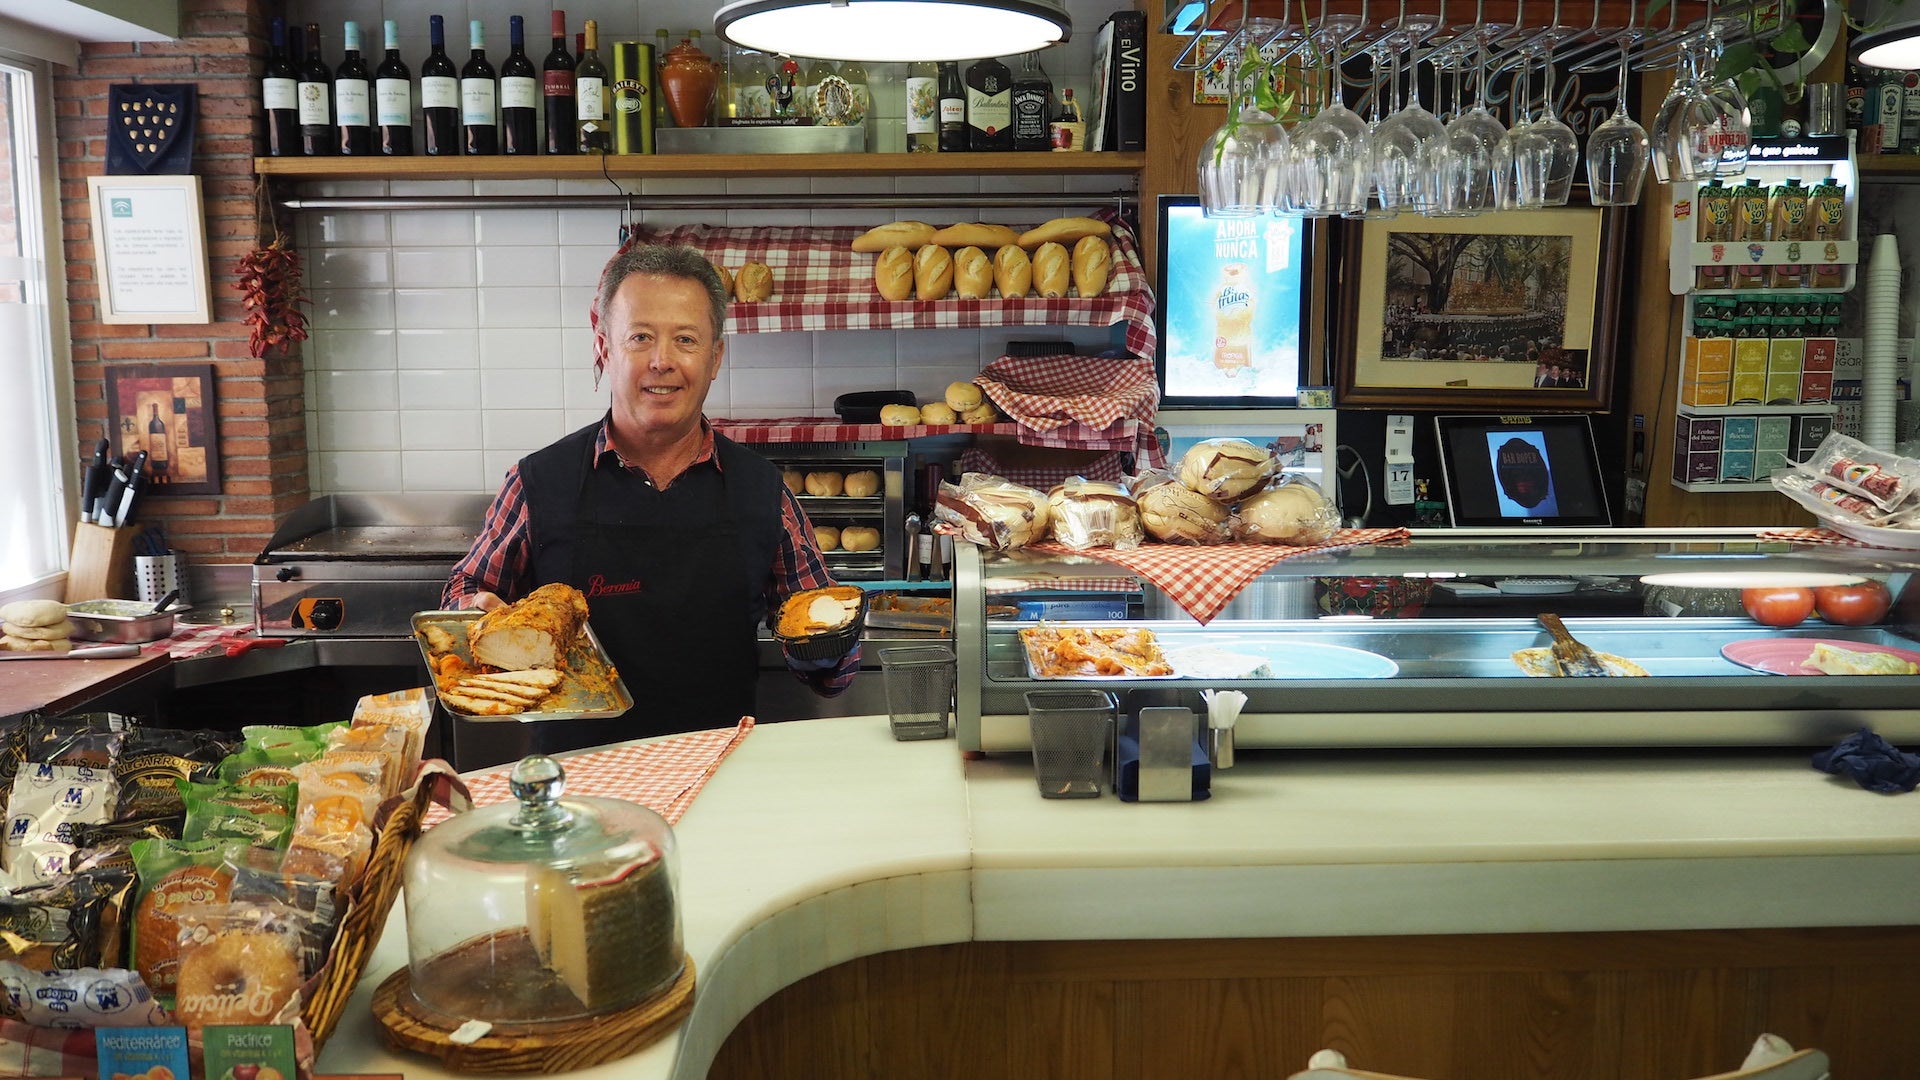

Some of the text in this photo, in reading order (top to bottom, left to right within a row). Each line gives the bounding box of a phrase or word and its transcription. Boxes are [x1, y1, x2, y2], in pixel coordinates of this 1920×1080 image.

[1121, 47, 1141, 92] Vino
[611, 79, 647, 96] BAILEYS
[1762, 147, 1781, 157] que
[1782, 145, 1819, 158] quieres
[1216, 220, 1257, 238] AHORA
[1215, 240, 1258, 258] NUNCA
[1391, 470, 1410, 482] 17
[588, 574, 641, 597] Beronia
[1030, 611, 1123, 620] M 100
[115, 758, 200, 777] ALGARROBO
[65, 787, 82, 804] M
[11, 819, 30, 835] M
[96, 993, 120, 1010] M
[184, 990, 274, 1018] Delicia
